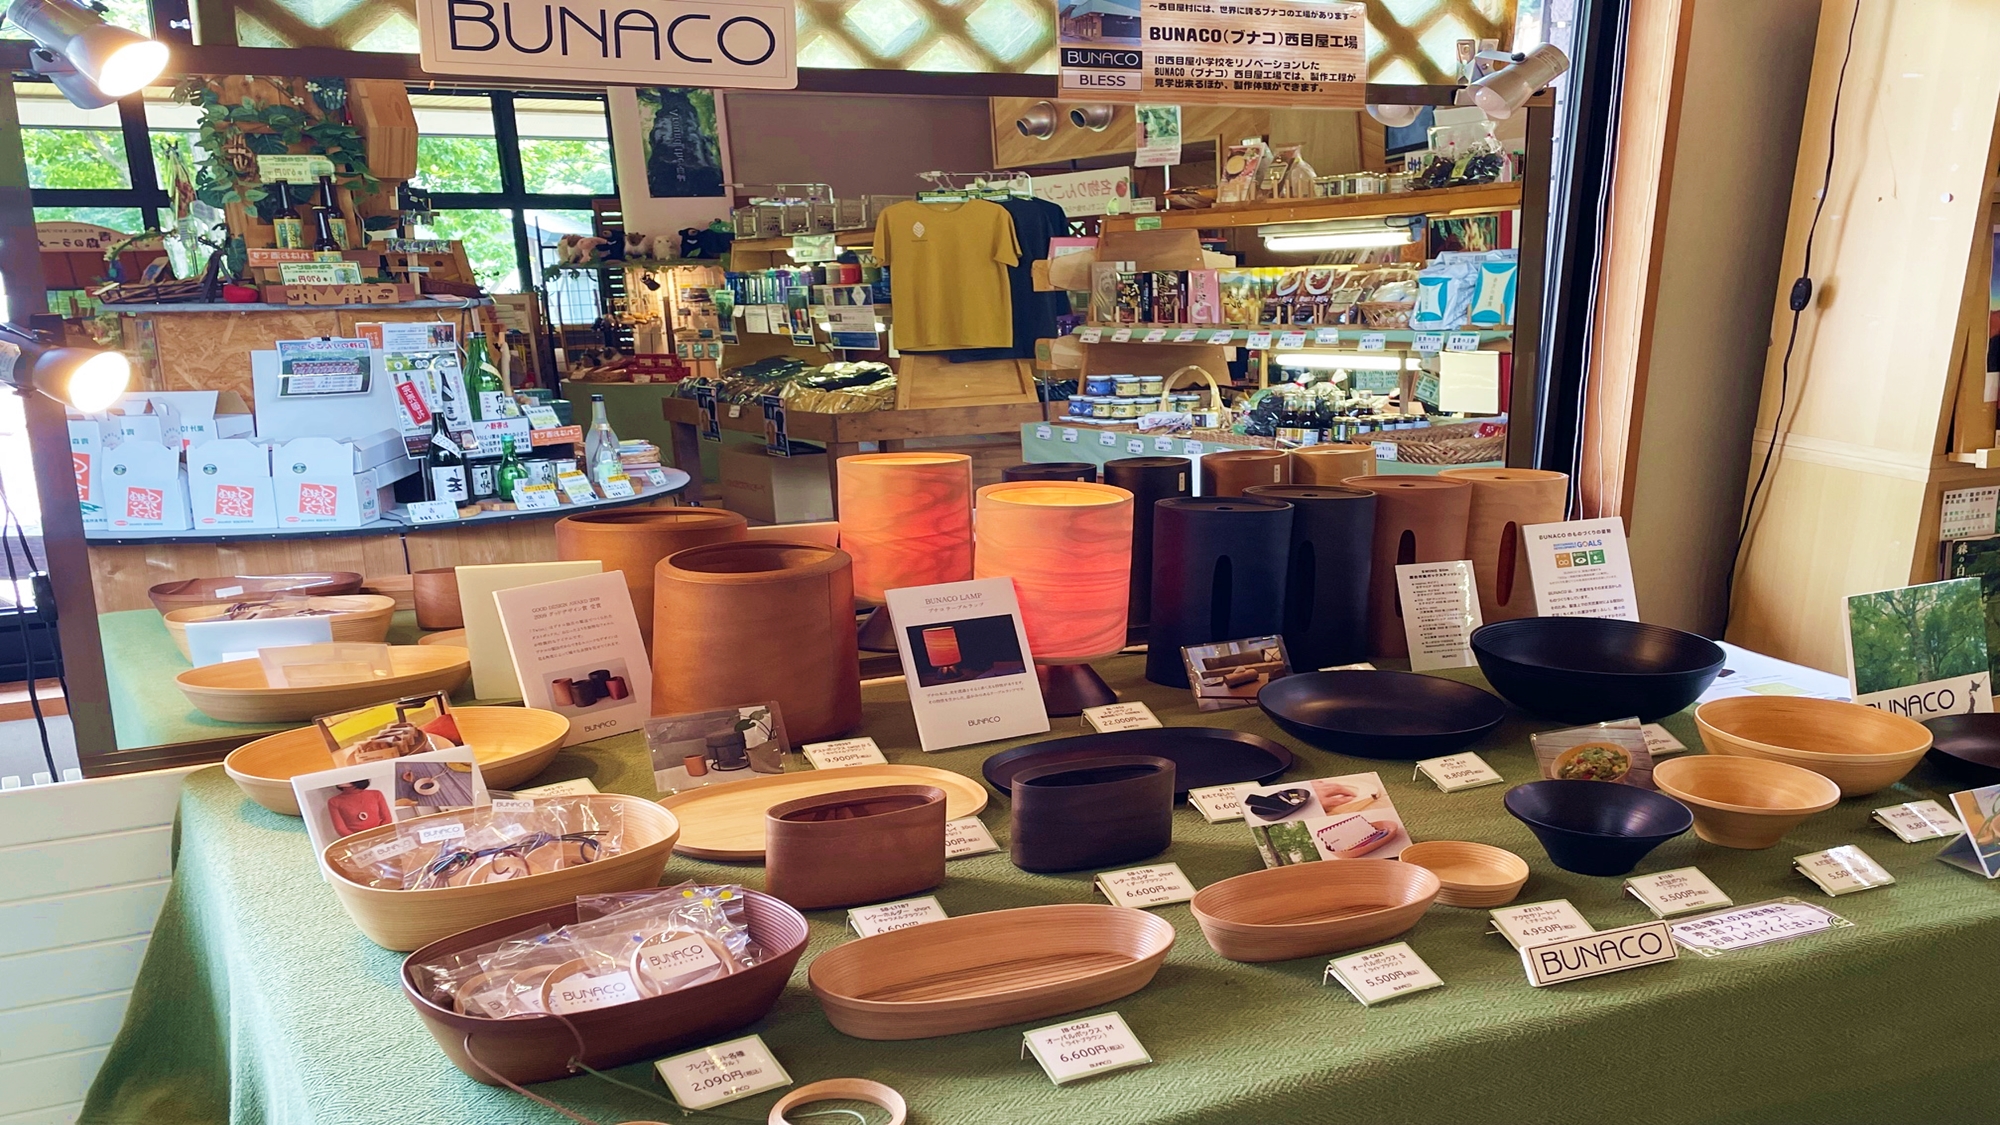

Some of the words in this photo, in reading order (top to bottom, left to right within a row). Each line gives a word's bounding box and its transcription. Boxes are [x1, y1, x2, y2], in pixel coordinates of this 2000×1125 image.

[447, 0, 775, 66] BUNACO
[1067, 50, 1139, 67] BUNACO
[1079, 74, 1126, 87] BLESS
[548, 602, 568, 611] DESIGN
[568, 599, 589, 608] AWARD
[925, 595, 958, 605] BUNACO
[960, 593, 983, 601] LAMP
[584, 719, 617, 733] BUNACO
[968, 716, 1000, 727] BUNACO
[423, 826, 460, 838] BUNACO
[1113, 873, 1155, 885] レターホルダー
[864, 909, 910, 921] レターホルダー
[649, 944, 703, 967] BUNACO
[1541, 932, 1663, 976] BUNACO
[562, 982, 626, 1001] BUNACO
[1059, 1043, 1125, 1063] 6,600円(税込)
[691, 1067, 763, 1092] 2,090円(税込)
